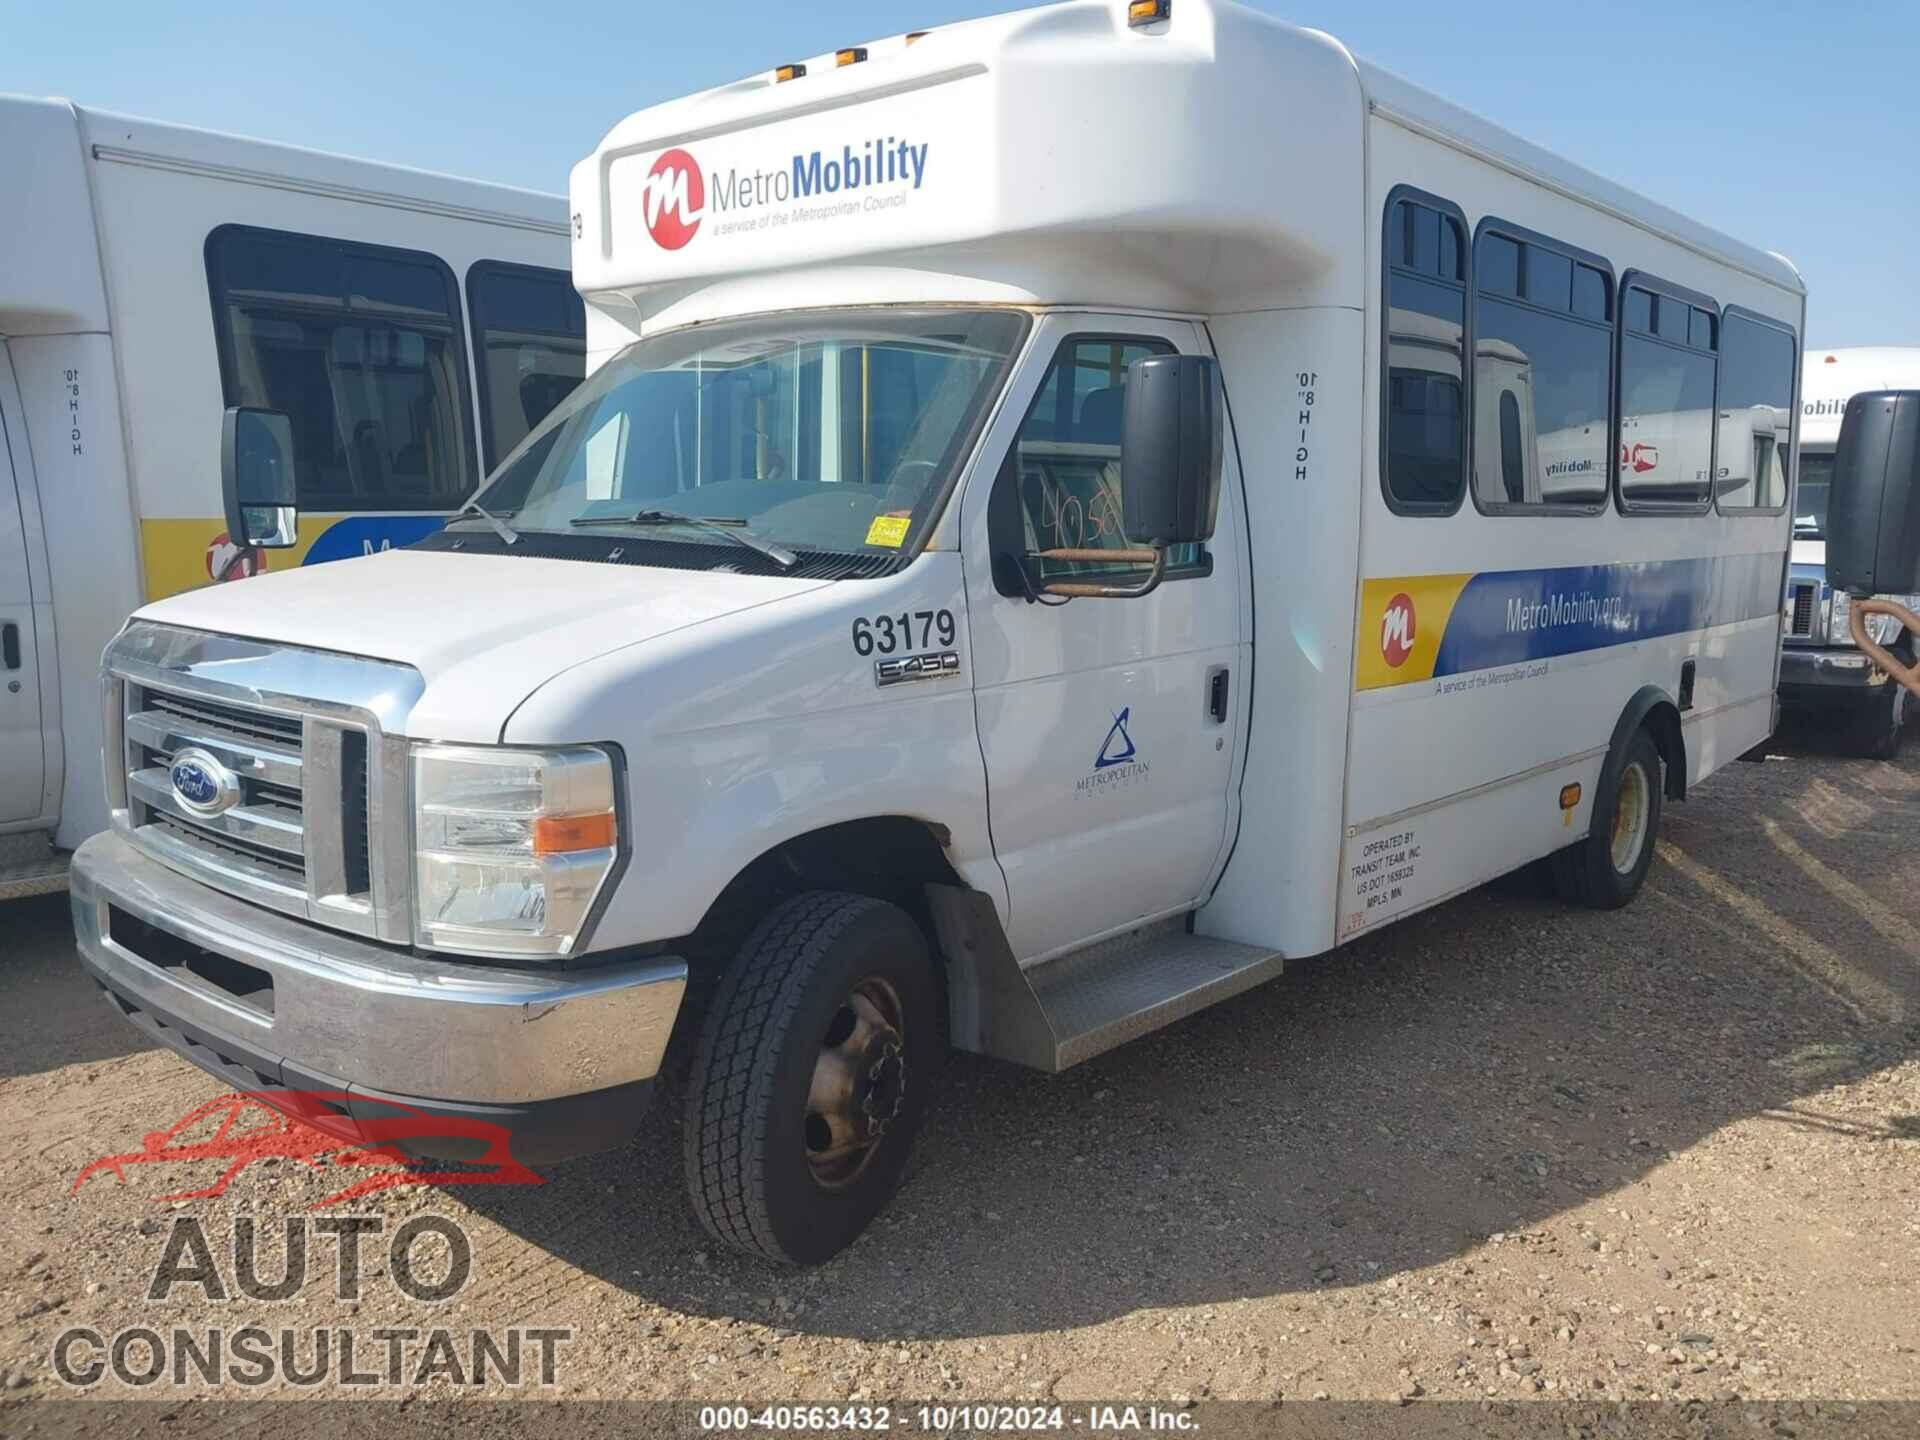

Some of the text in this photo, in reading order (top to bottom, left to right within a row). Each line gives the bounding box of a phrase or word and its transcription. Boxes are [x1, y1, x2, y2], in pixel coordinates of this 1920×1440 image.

[711, 136, 928, 213] MetroMobility
[721, 218, 757, 235] service
[758, 213, 770, 230] of
[771, 209, 789, 227] the
[791, 200, 861, 224] Metropolitan
[863, 191, 907, 212] Council
[852, 609, 956, 656] 63179
[1435, 661, 1549, 695] A service of the Metropolitan Council
[177, 766, 209, 796] Ford
[1076, 762, 1150, 791] METROPOLITAN
[1363, 832, 1415, 857] OPERATED BY
[1352, 859, 1382, 880] TRANSIT
[1386, 851, 1405, 867] TEAM
[1357, 881, 1368, 895] US
[1369, 875, 1385, 891] DOT
[1391, 887, 1402, 900] MN
